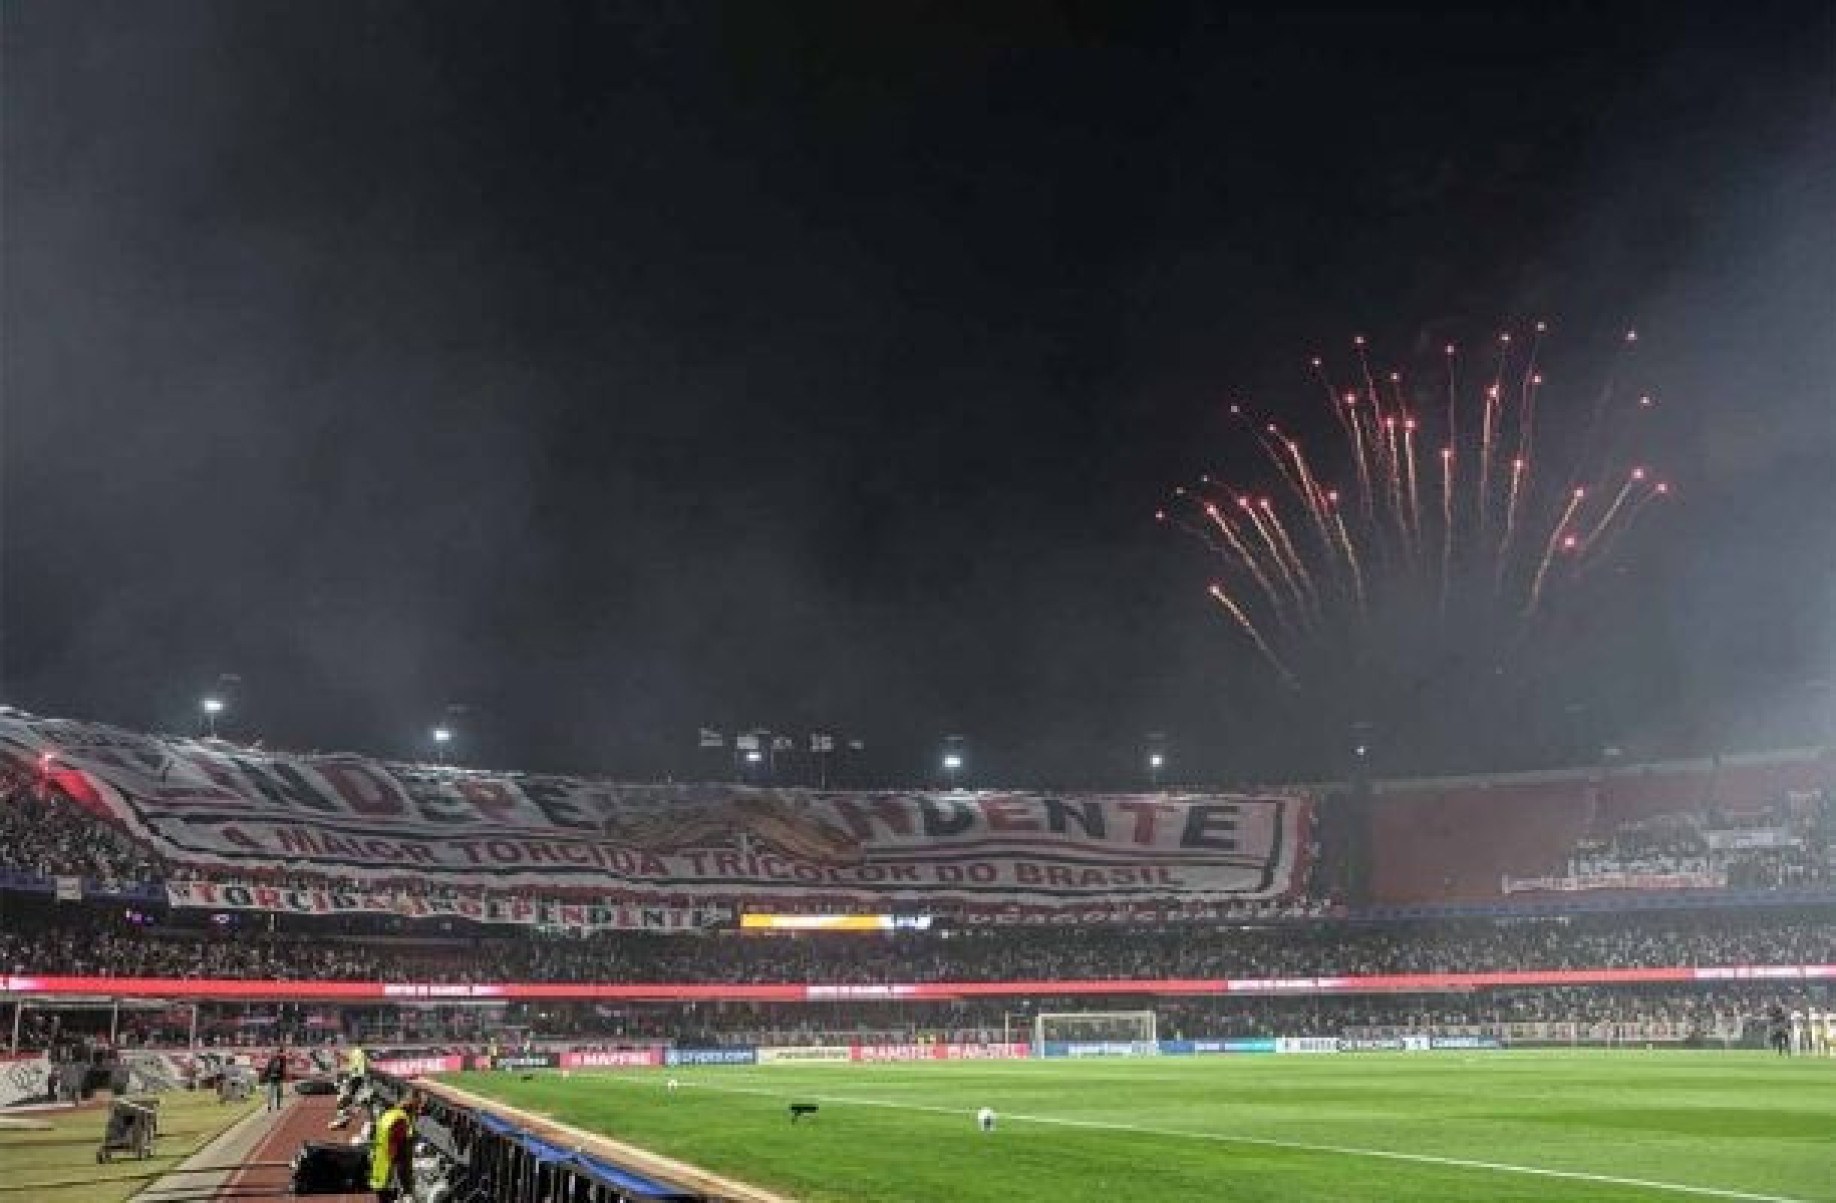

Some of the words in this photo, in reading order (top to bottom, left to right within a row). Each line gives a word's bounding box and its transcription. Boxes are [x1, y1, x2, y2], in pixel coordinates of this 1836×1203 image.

[272, 826, 441, 864] MAIOR
[456, 839, 669, 876] TORCIDA
[682, 850, 923, 883] TRICOLOR
[936, 862, 997, 883] DO
[1013, 861, 1184, 888] BRASIL
